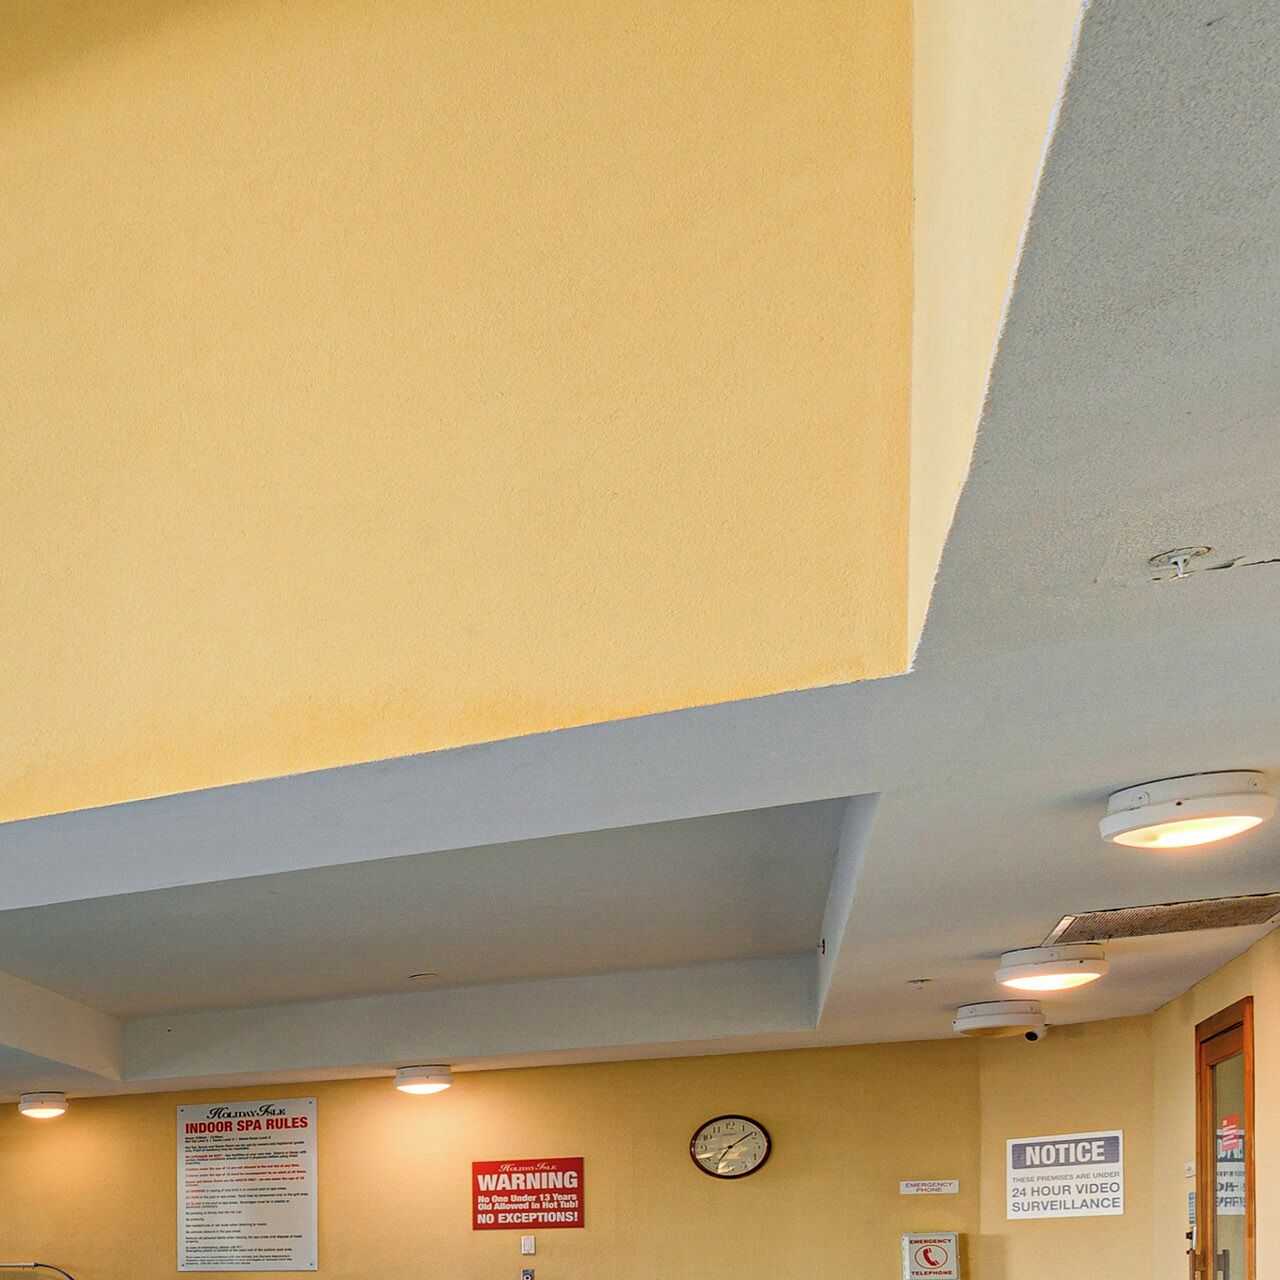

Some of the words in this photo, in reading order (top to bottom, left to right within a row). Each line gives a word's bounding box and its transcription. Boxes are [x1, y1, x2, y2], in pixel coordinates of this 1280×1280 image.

[185, 1121, 232, 1134] INDOOR
[237, 1119, 262, 1131] SPA
[266, 1116, 308, 1130] RULES
[1025, 1141, 1105, 1166] NOTICE
[477, 1171, 578, 1191] WARNING
[1036, 1174, 1073, 1182] PREMISES
[1012, 1188, 1026, 1198] 24
[1031, 1185, 1071, 1196] HOUR
[1075, 1182, 1120, 1194] VIDEO
[478, 1195, 490, 1204] No
[492, 1194, 509, 1203] One
[511, 1193, 536, 1202] Under
[539, 1193, 551, 1201] 13
[552, 1193, 577, 1201] Years
[478, 1202, 492, 1211] Old
[494, 1201, 529, 1210] Allowed
[531, 1201, 540, 1209] In
[542, 1201, 558, 1209] Hot
[560, 1200, 578, 1208] Tub!
[1012, 1197, 1121, 1213] SURVEILLANCE
[477, 1213, 494, 1224] NO
[498, 1211, 578, 1223] EXCEPTIONS!
